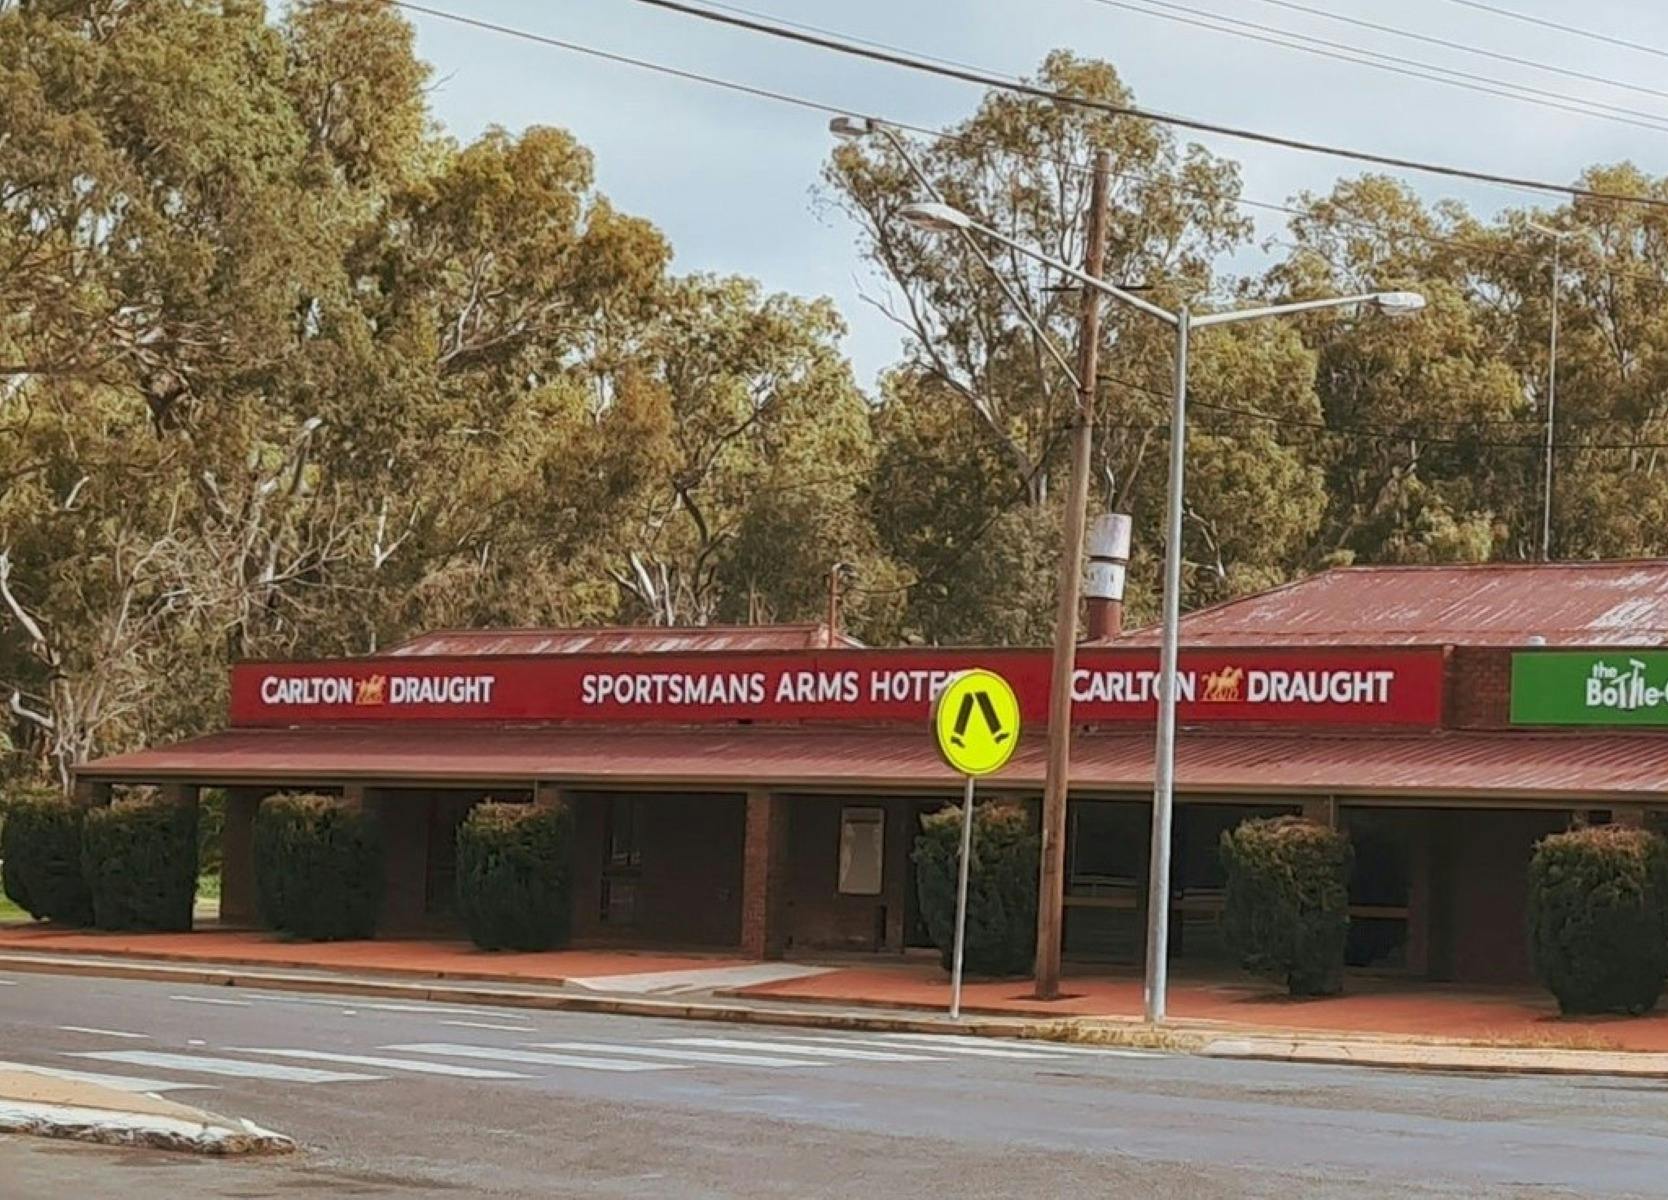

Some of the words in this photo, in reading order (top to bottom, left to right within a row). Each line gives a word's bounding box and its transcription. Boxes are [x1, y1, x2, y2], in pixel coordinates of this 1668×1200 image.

[1592, 660, 1617, 678] the
[261, 676, 353, 704] CARLTON
[390, 676, 495, 704] DRAUGHT
[581, 672, 766, 704] SPORTSMANS
[775, 671, 859, 703] ARMS
[870, 670, 949, 702] HOTE
[1247, 670, 1395, 703] DRAUGHT
